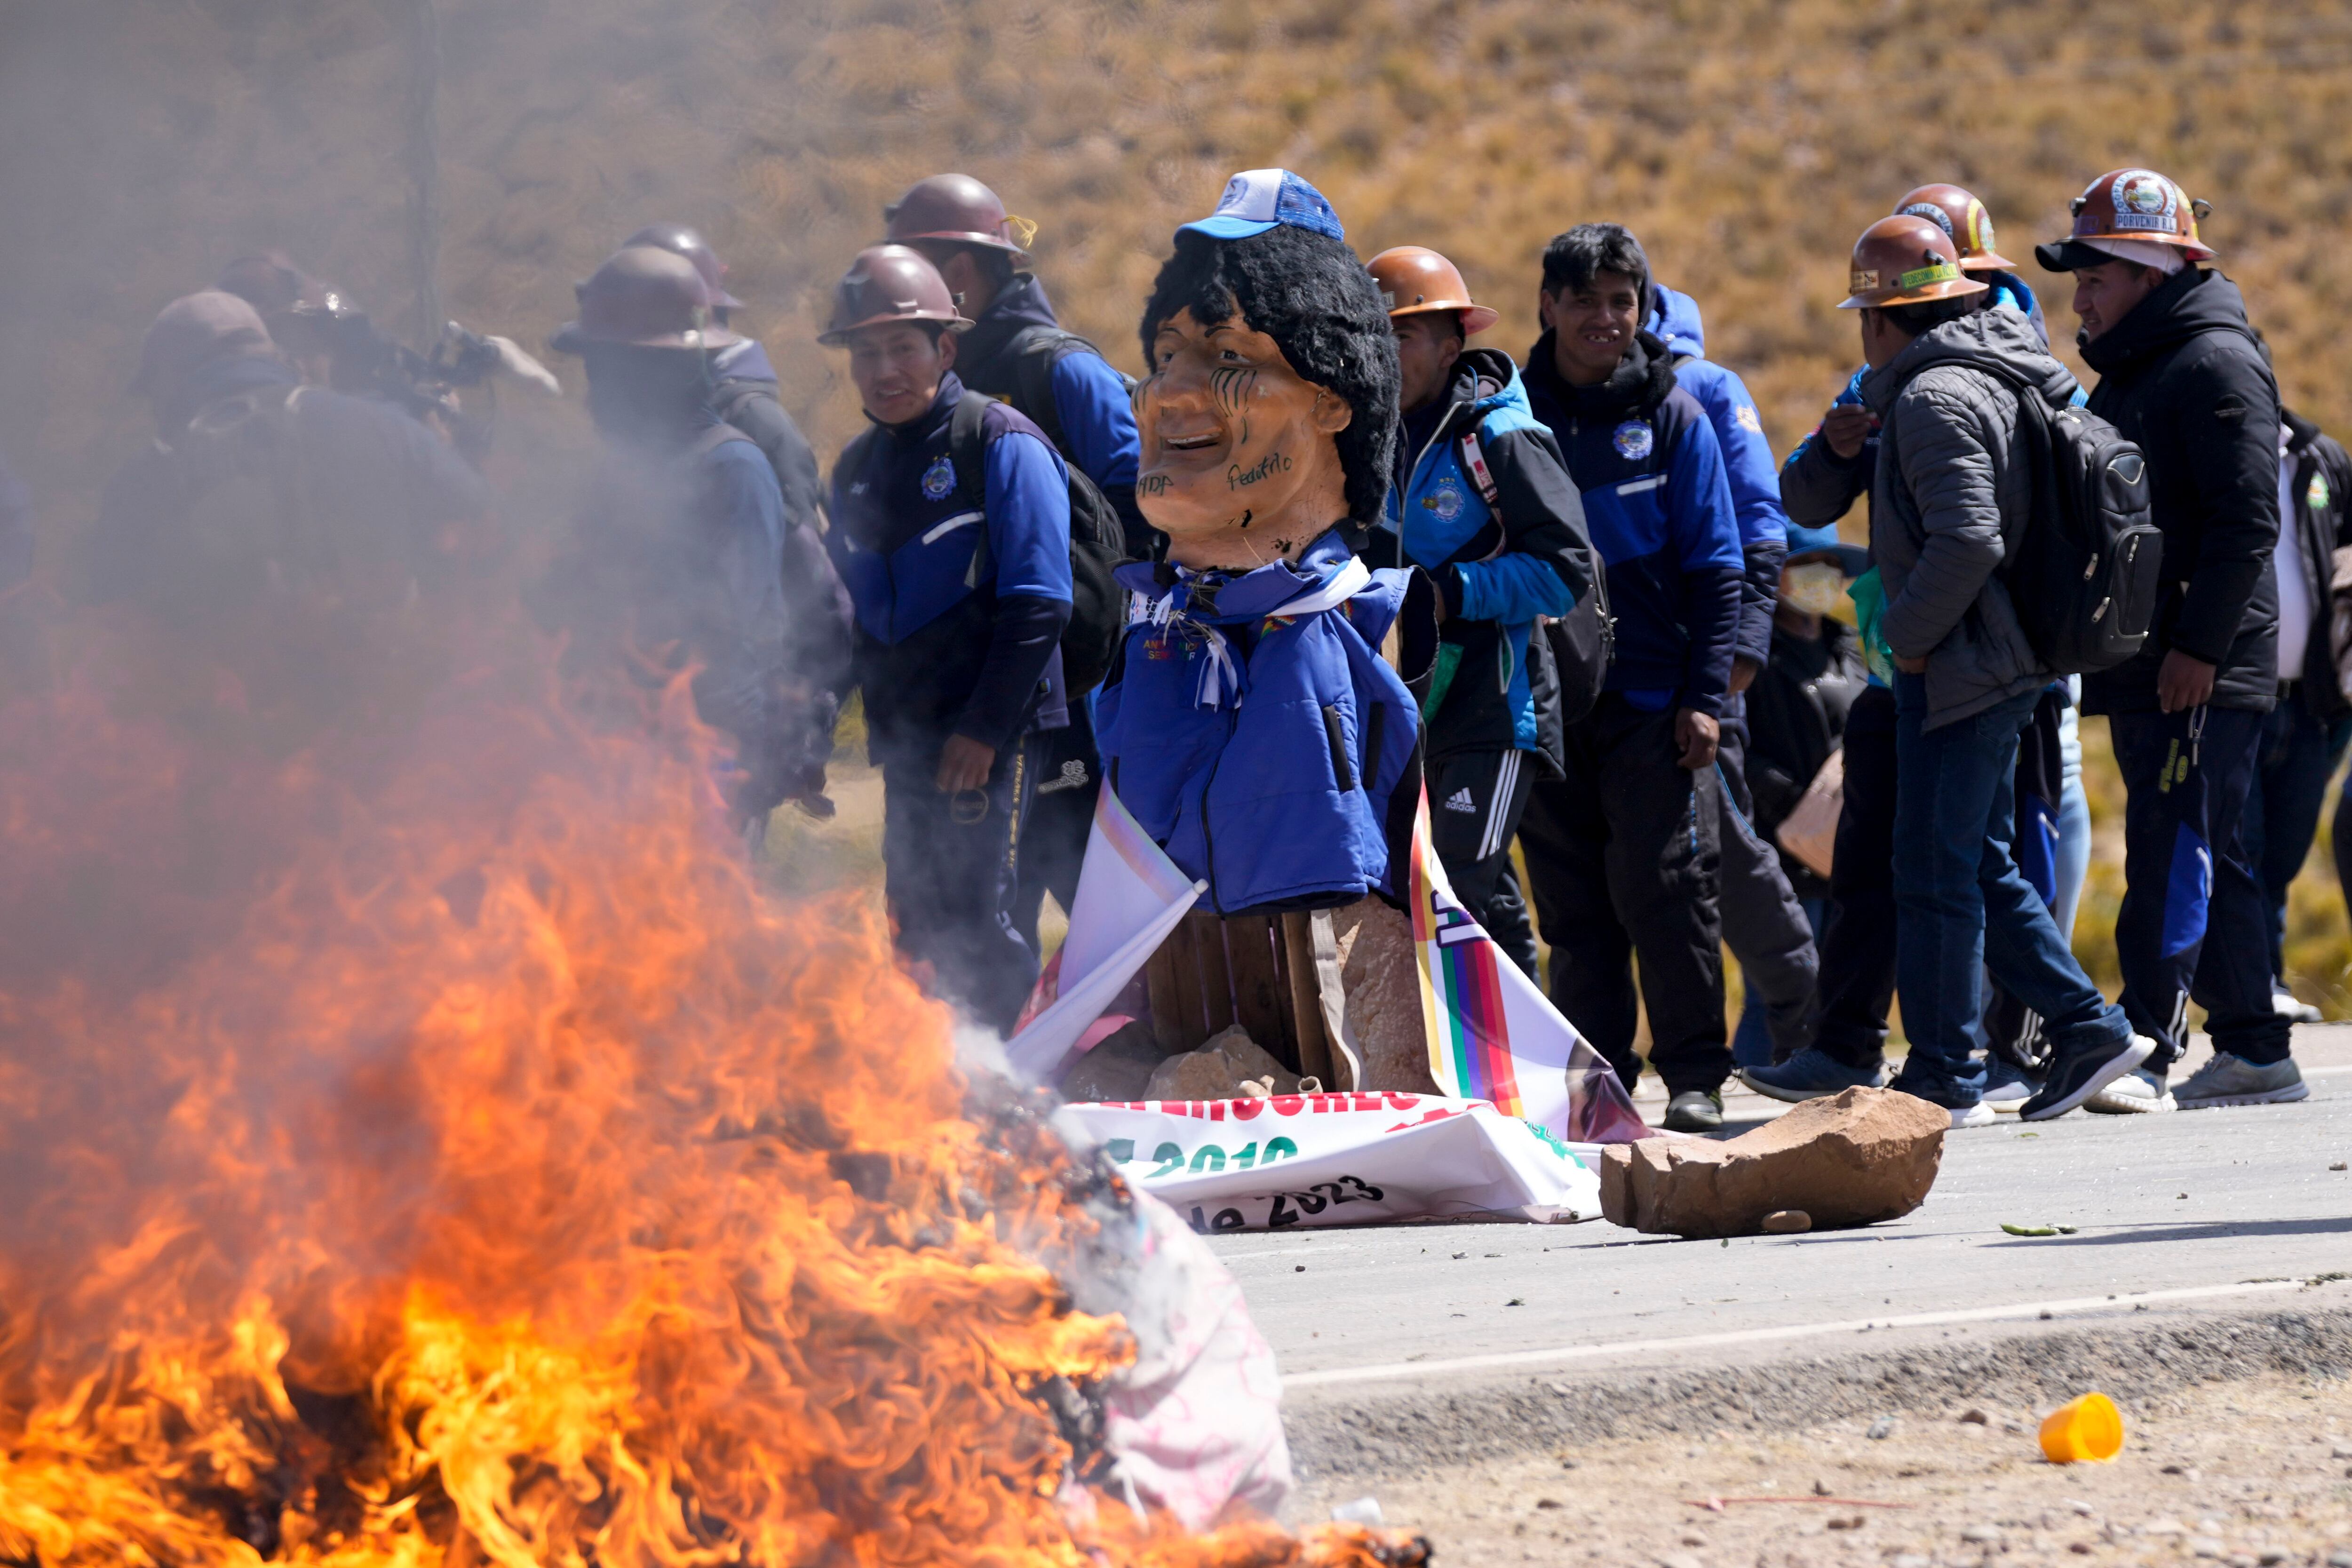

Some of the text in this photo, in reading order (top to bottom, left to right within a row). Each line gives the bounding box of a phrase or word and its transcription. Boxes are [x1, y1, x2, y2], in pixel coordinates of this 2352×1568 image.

[2118, 215, 2160, 228] PORVENIR
[1445, 801, 1477, 813] adidas
[1266, 1175, 1384, 1227] 2023
